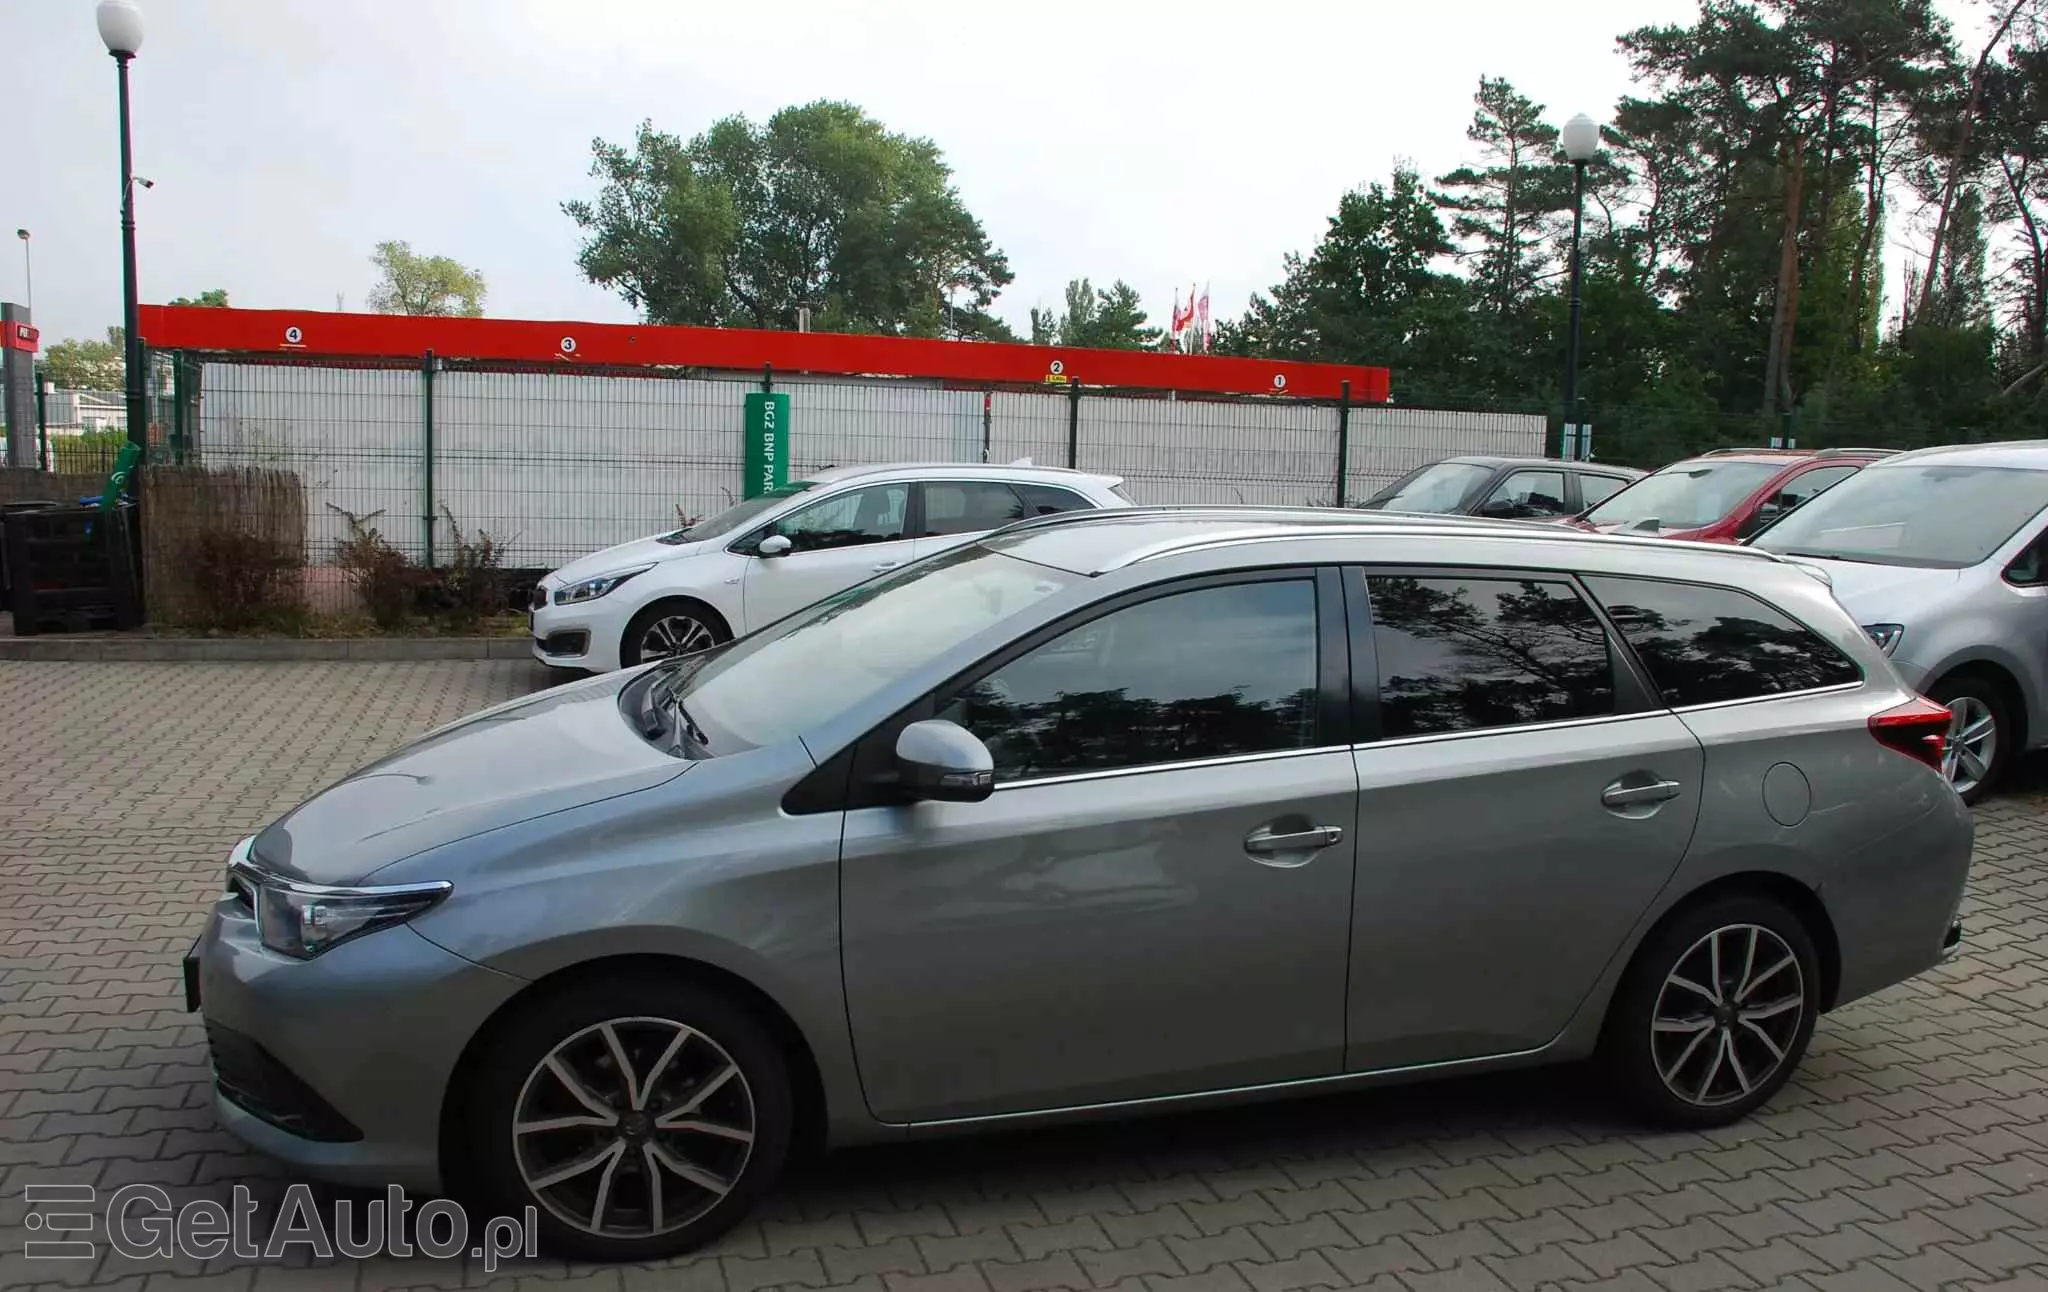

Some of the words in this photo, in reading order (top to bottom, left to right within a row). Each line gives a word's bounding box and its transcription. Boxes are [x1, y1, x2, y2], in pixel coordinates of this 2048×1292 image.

[288, 328, 299, 341] 4
[563, 338, 573, 350] 3
[763, 432, 775, 461] BNP
